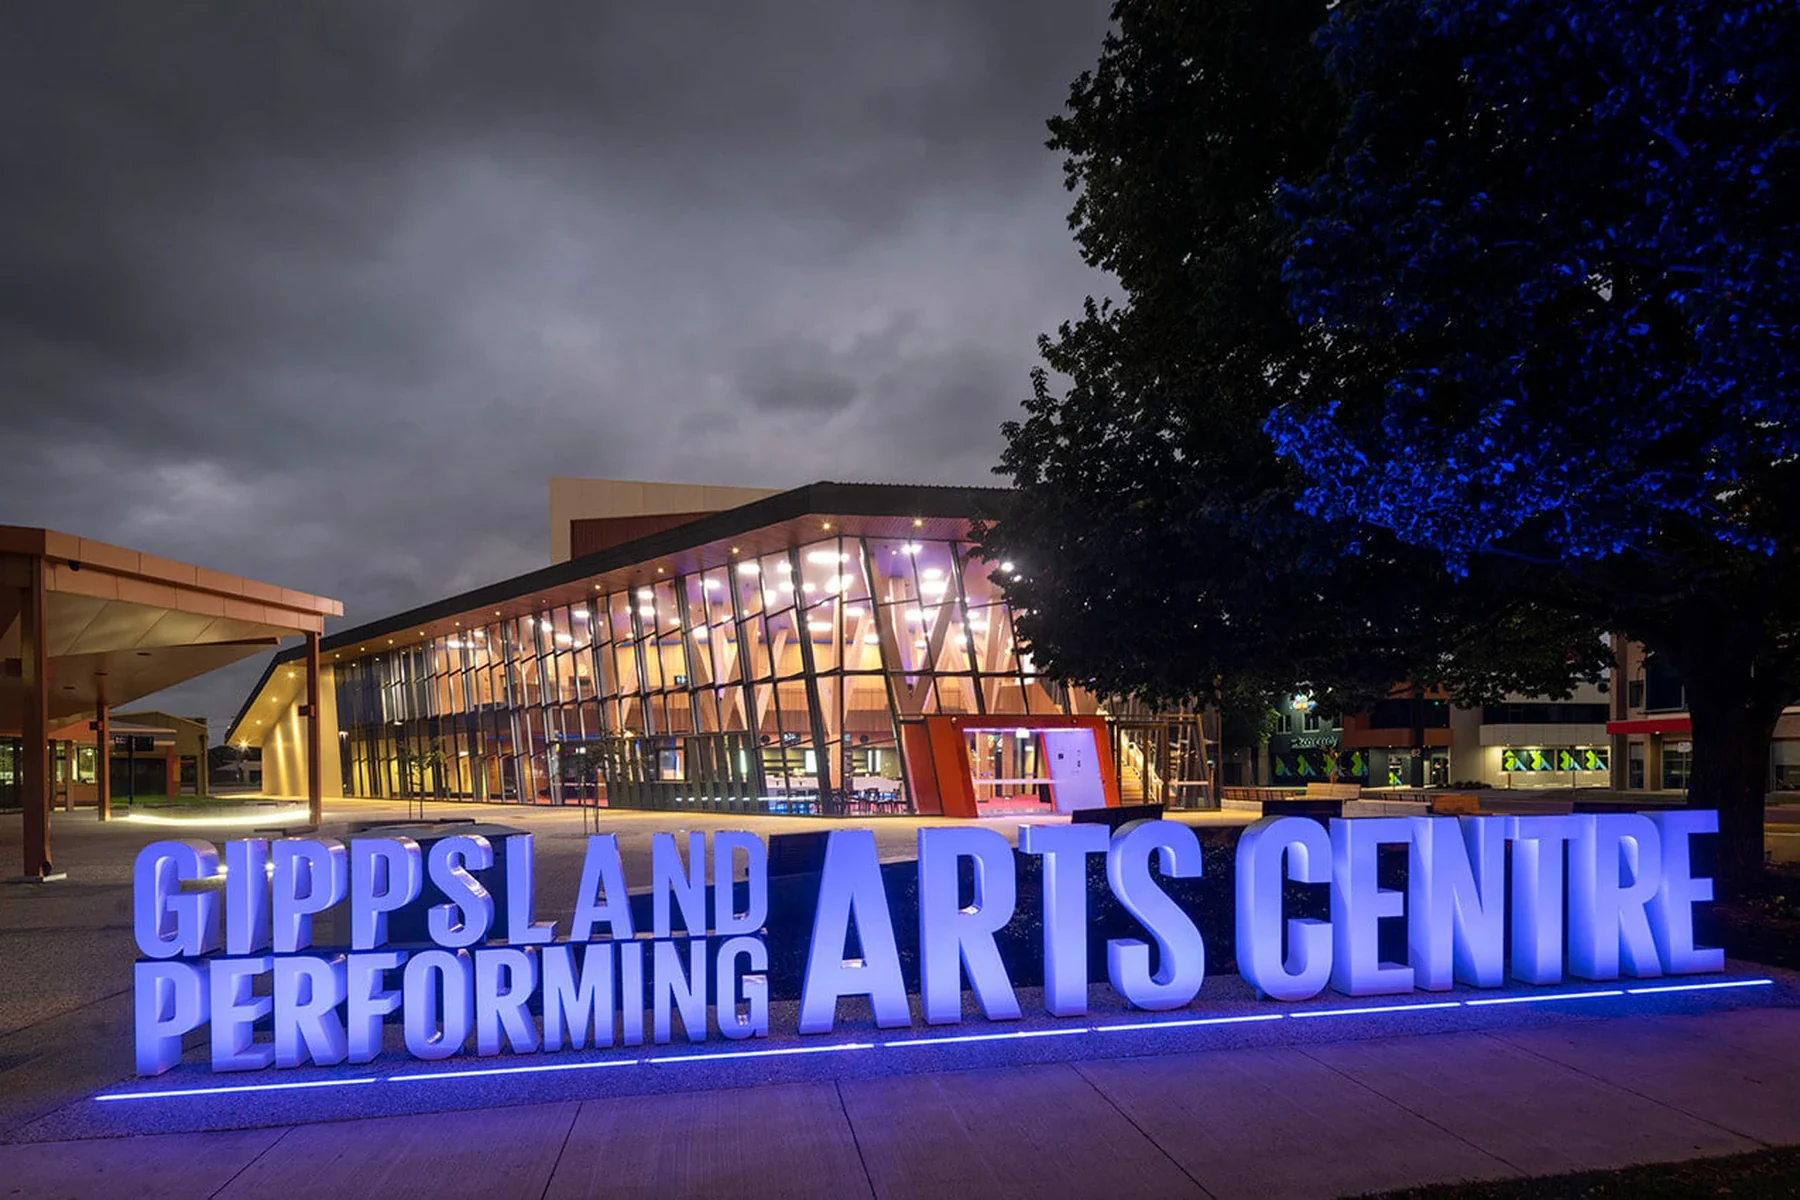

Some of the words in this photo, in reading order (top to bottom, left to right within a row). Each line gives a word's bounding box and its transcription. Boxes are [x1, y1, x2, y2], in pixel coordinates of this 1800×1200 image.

[133, 832, 768, 959] GIPPSLAND
[799, 819, 1205, 1035] ARTS
[1235, 809, 1725, 1002] CENTRE
[134, 936, 769, 1077] PERFORMING
